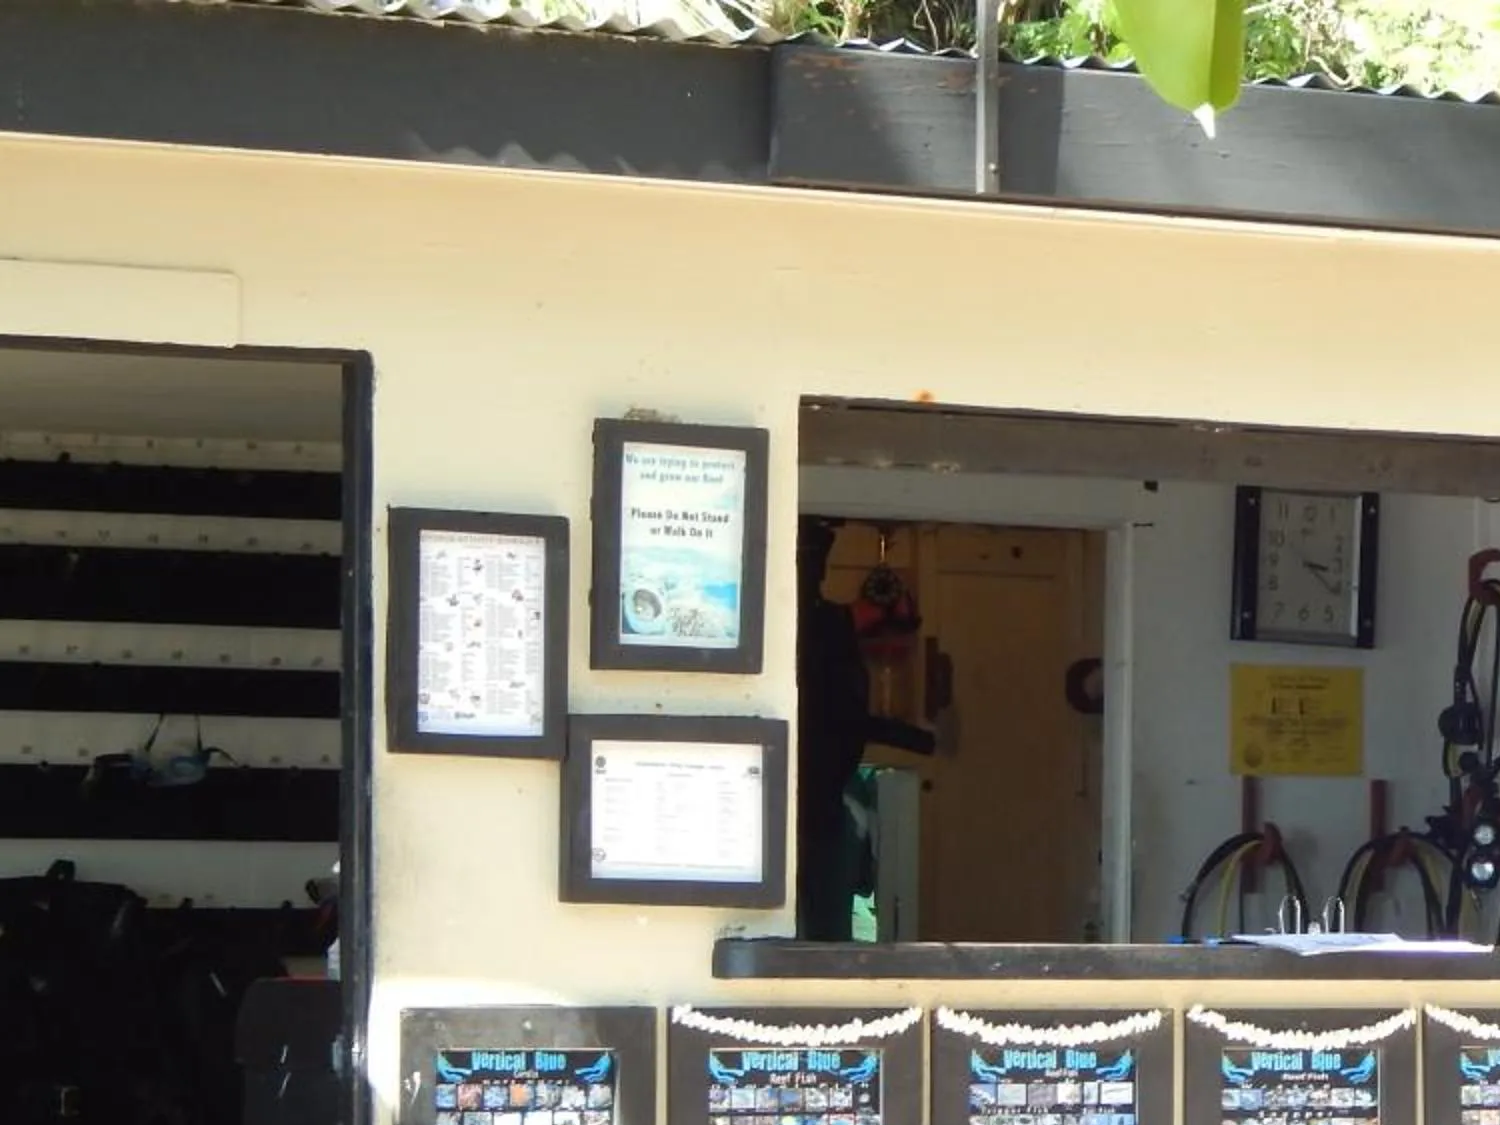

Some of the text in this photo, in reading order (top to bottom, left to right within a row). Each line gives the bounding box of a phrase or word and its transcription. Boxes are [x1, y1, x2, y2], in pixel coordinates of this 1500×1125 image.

[631, 507, 729, 524] Please Do Not Stand
[664, 525, 686, 537] Walk
[689, 527, 702, 538] On
[472, 1050, 566, 1071] Vertical Blue
[742, 1050, 841, 1071] Vertical Blue
[1003, 1050, 1097, 1070] Vertical Blue
[1251, 1051, 1341, 1071] Vertical Blue
